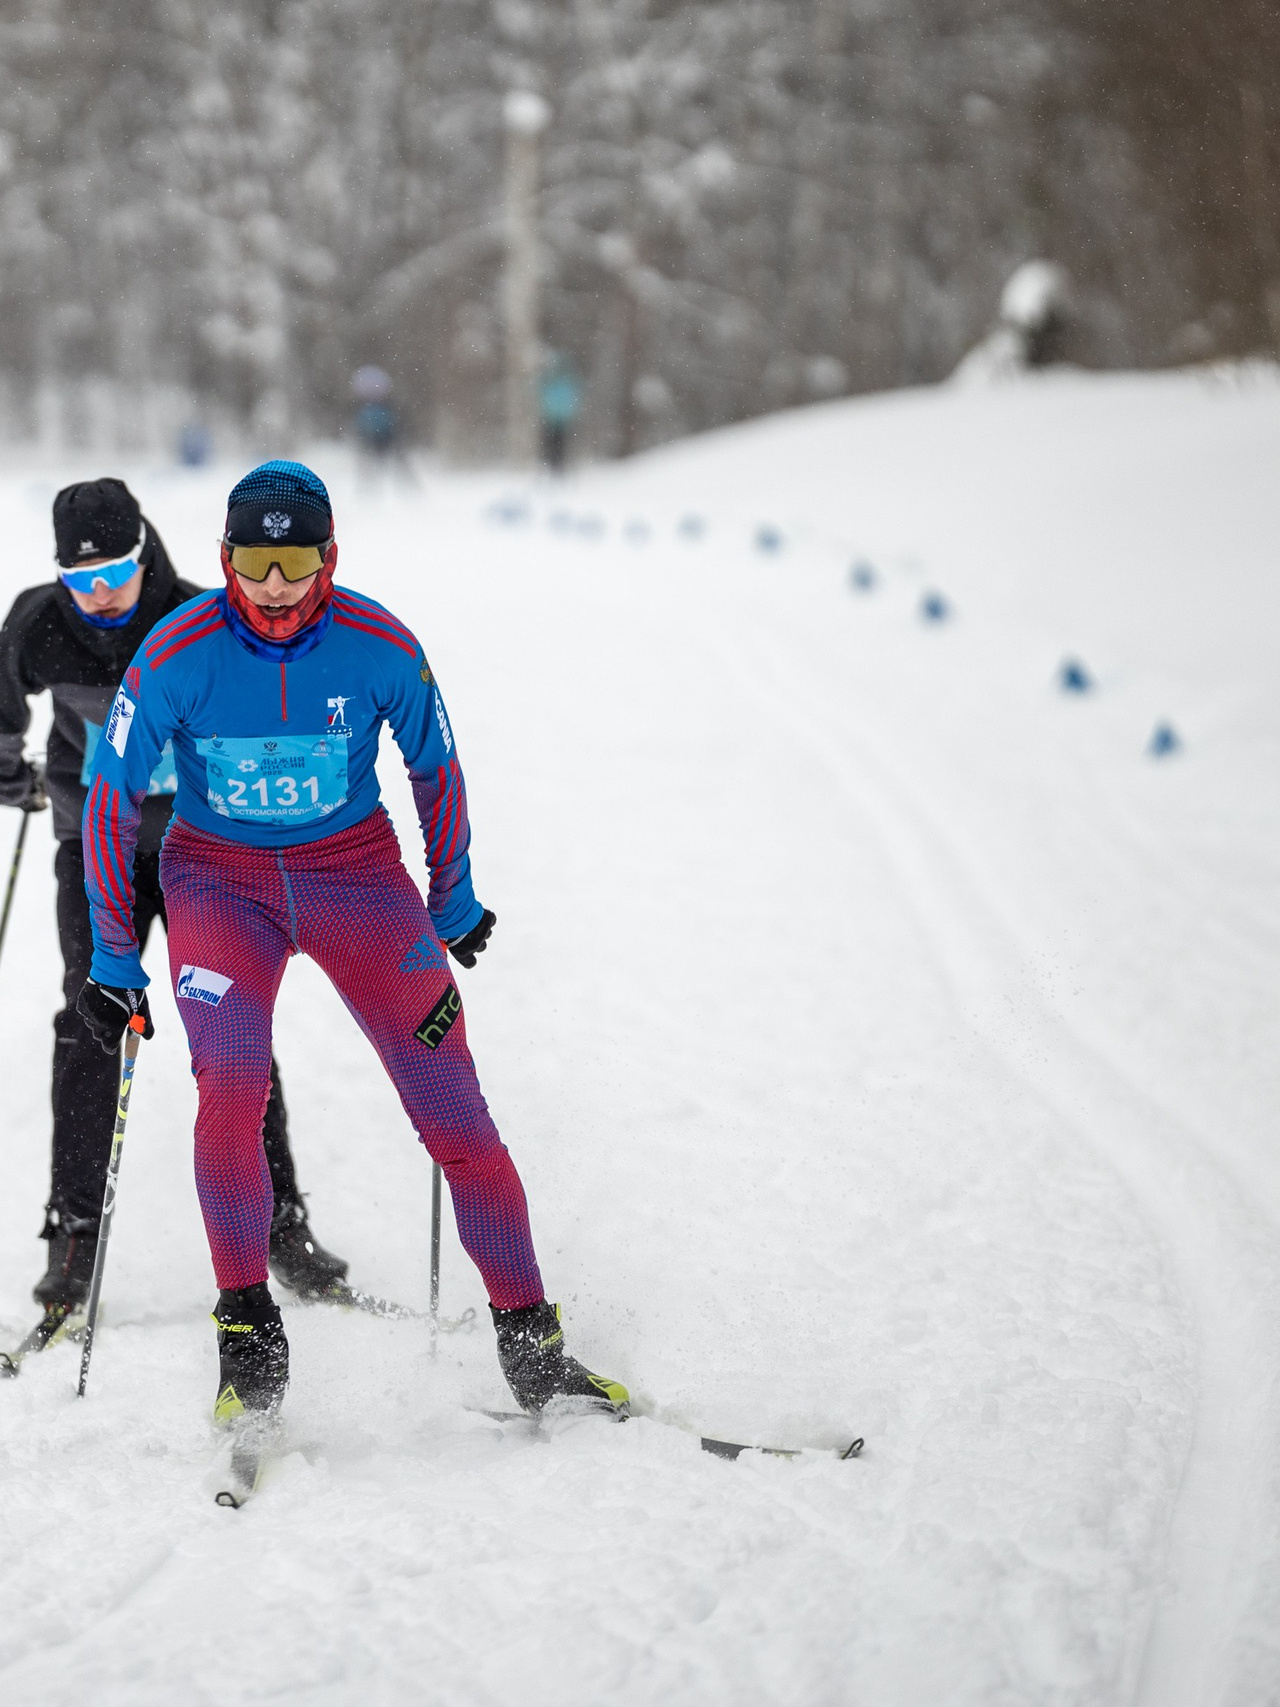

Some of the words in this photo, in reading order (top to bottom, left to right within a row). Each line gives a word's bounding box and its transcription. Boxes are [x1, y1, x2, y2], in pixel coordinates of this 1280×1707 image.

[260, 756, 305, 766] ЛЫЖНЯ
[260, 763, 305, 771] РОССИИ
[227, 776, 320, 806] 2131
